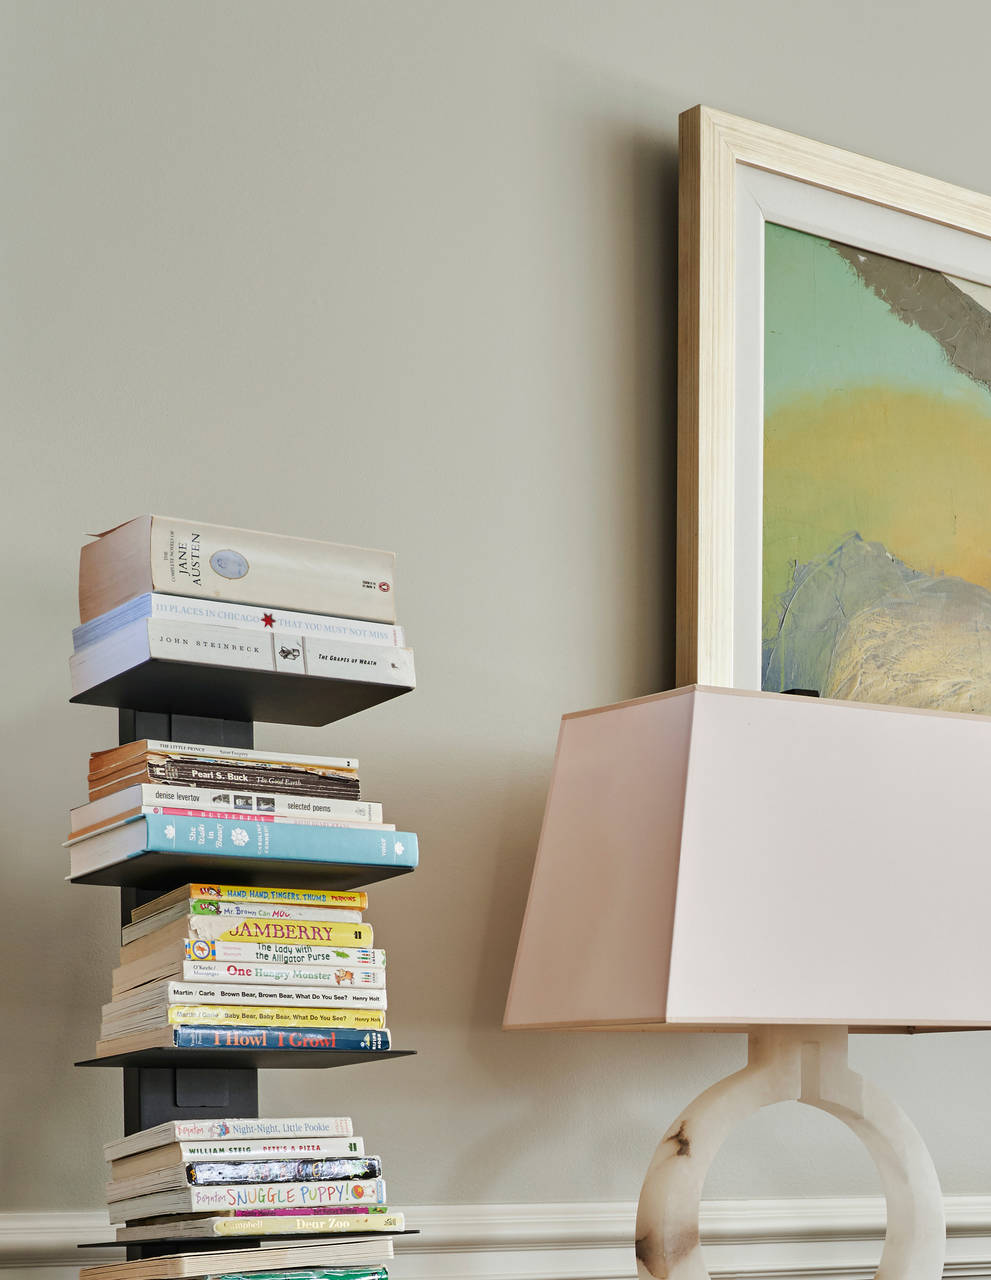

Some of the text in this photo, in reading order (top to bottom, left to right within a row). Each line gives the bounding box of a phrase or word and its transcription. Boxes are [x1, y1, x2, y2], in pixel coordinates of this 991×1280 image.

[179, 542, 188, 575] JANE
[192, 533, 202, 585] AUSTEN
[155, 791, 331, 814] denise levertov selected poems
[229, 924, 332, 941] JAMBERRY
[256, 951, 330, 965] the Alligator Purse
[227, 965, 252, 977] One
[255, 968, 290, 980] Hungry
[293, 970, 331, 980] Monster
[176, 1123, 330, 1135] Boynton Night-Night, Little Pookie
[195, 1182, 349, 1206] Boynton SNUGGLE PUPPY!
[296, 1218, 350, 1230] Dear Zoo
